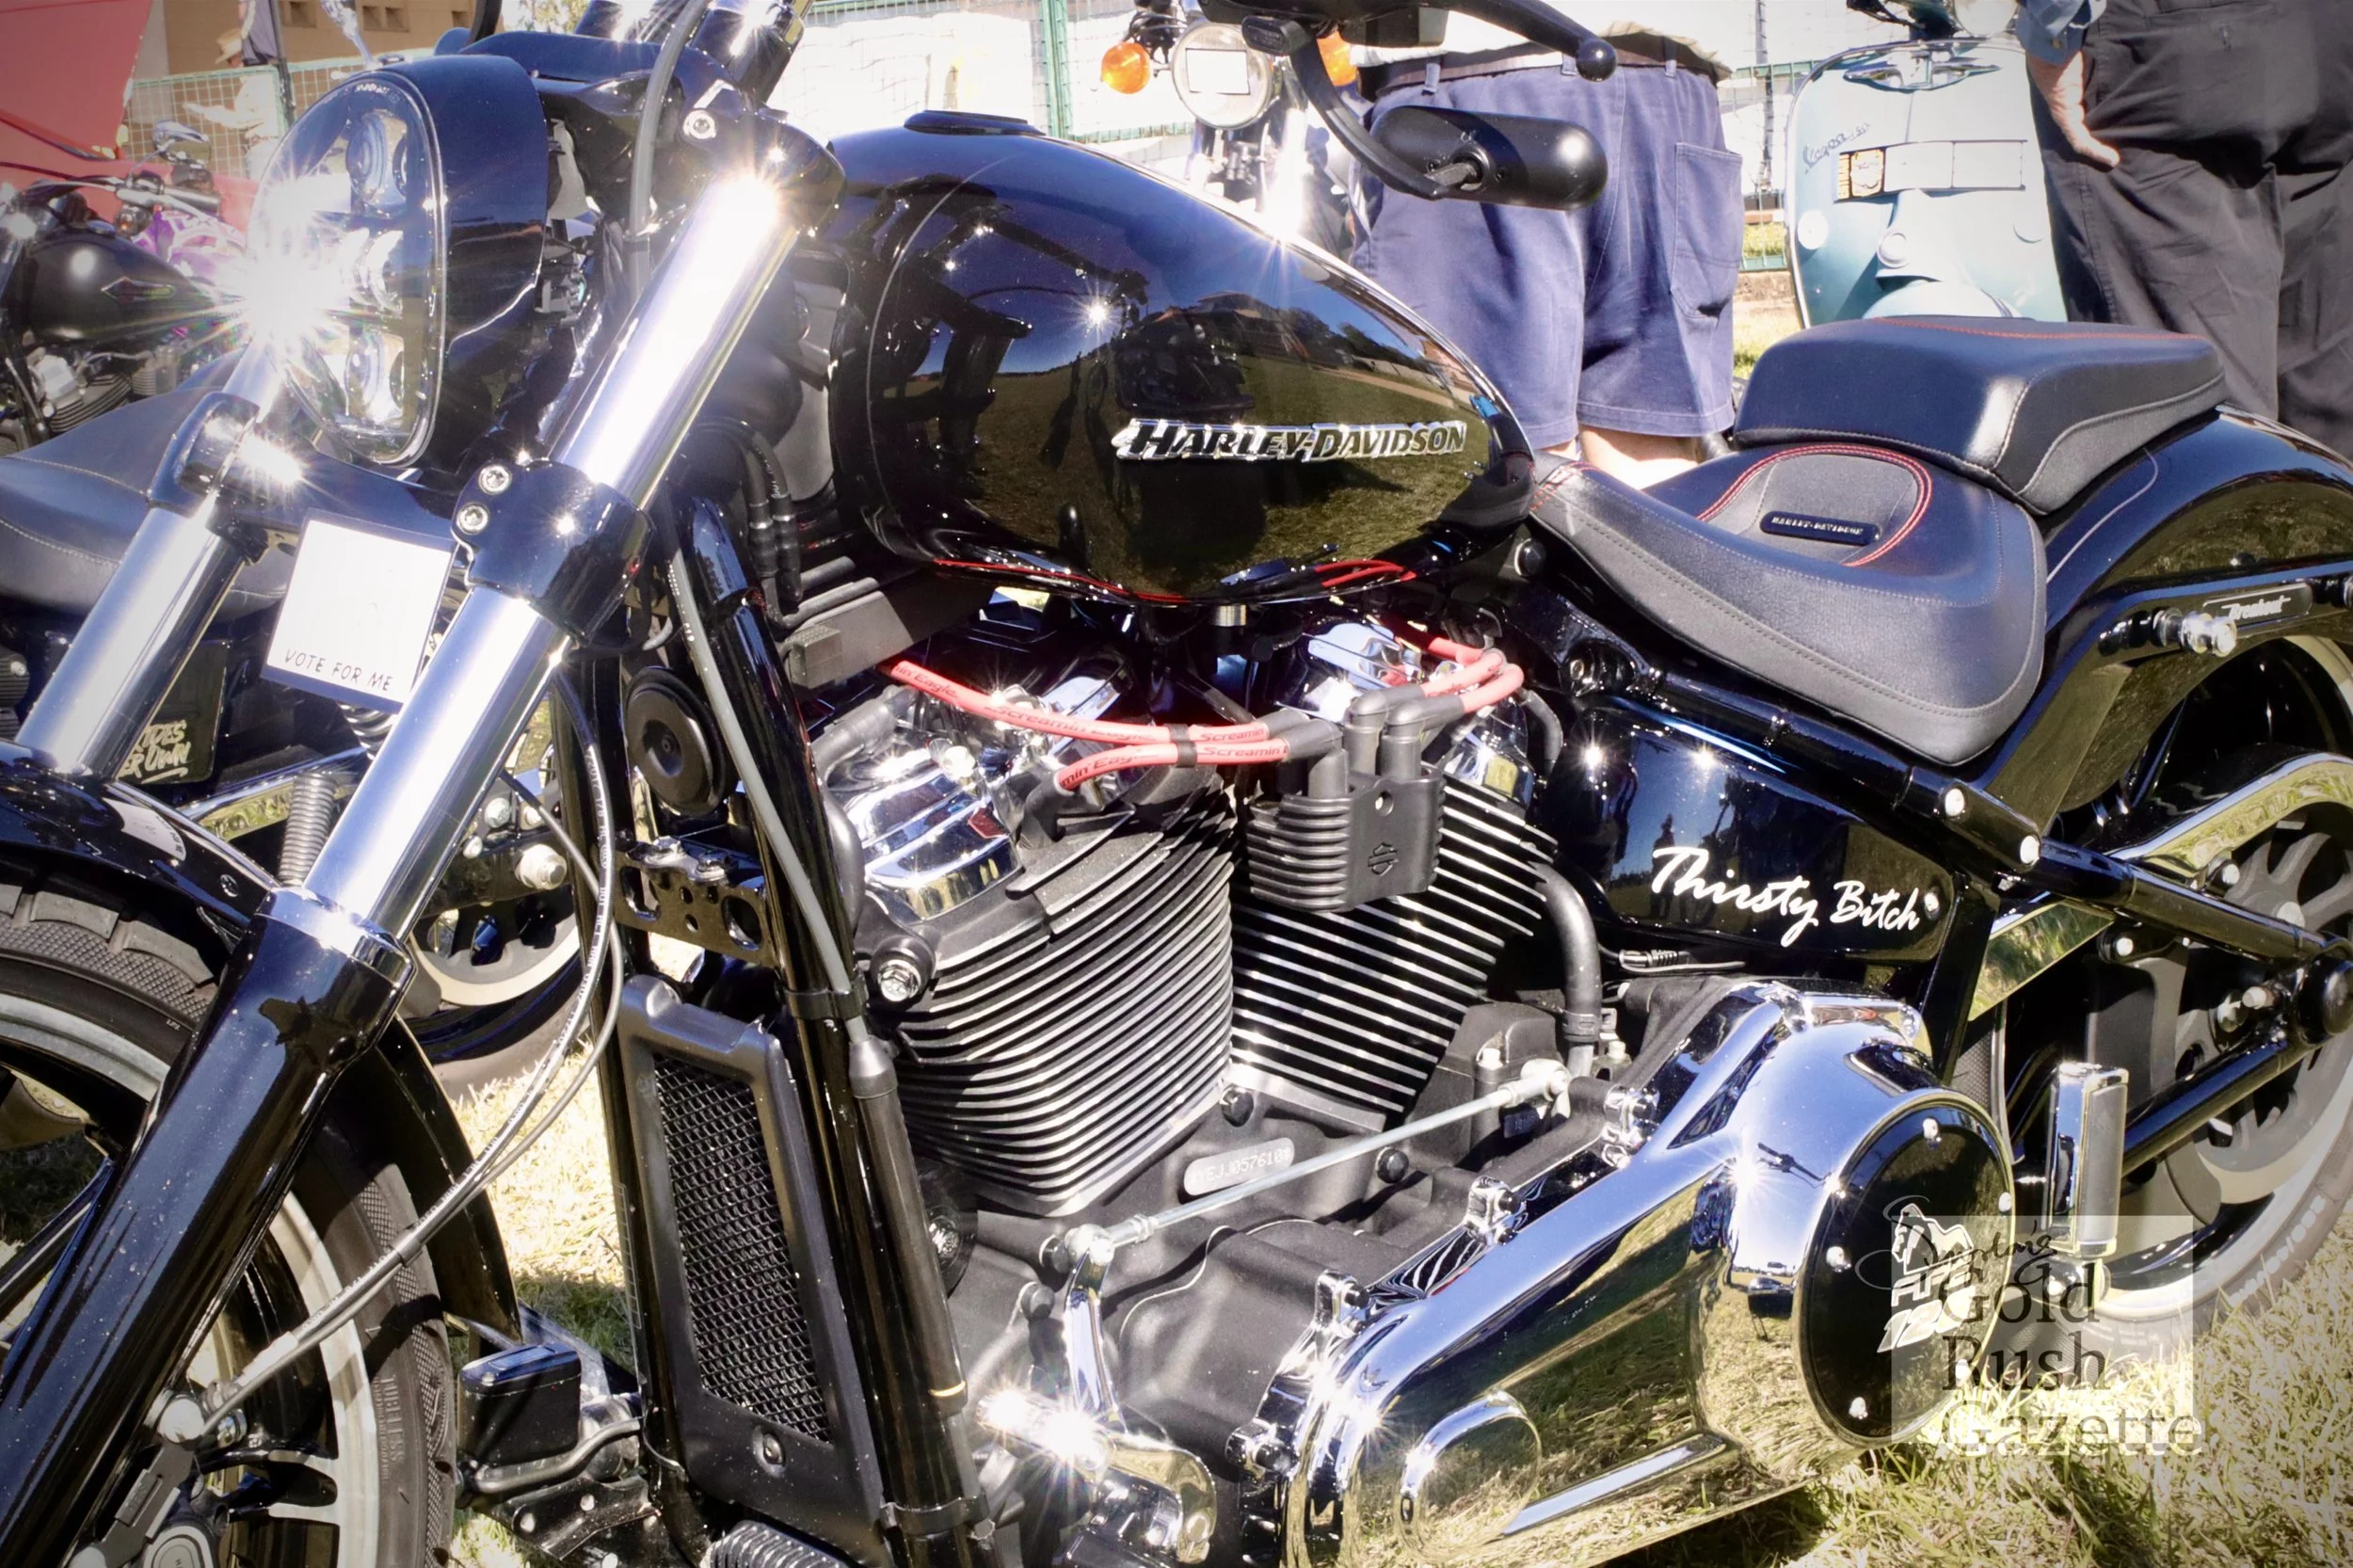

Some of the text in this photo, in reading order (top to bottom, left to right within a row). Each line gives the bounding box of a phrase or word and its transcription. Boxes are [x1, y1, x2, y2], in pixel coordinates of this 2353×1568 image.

[1113, 419, 1466, 461] HARLEY-DAVIDSON
[284, 648, 392, 691] VOTE FOR ME
[145, 742, 191, 771] OWN
[1651, 846, 1920, 947] Thirsty Bitch
